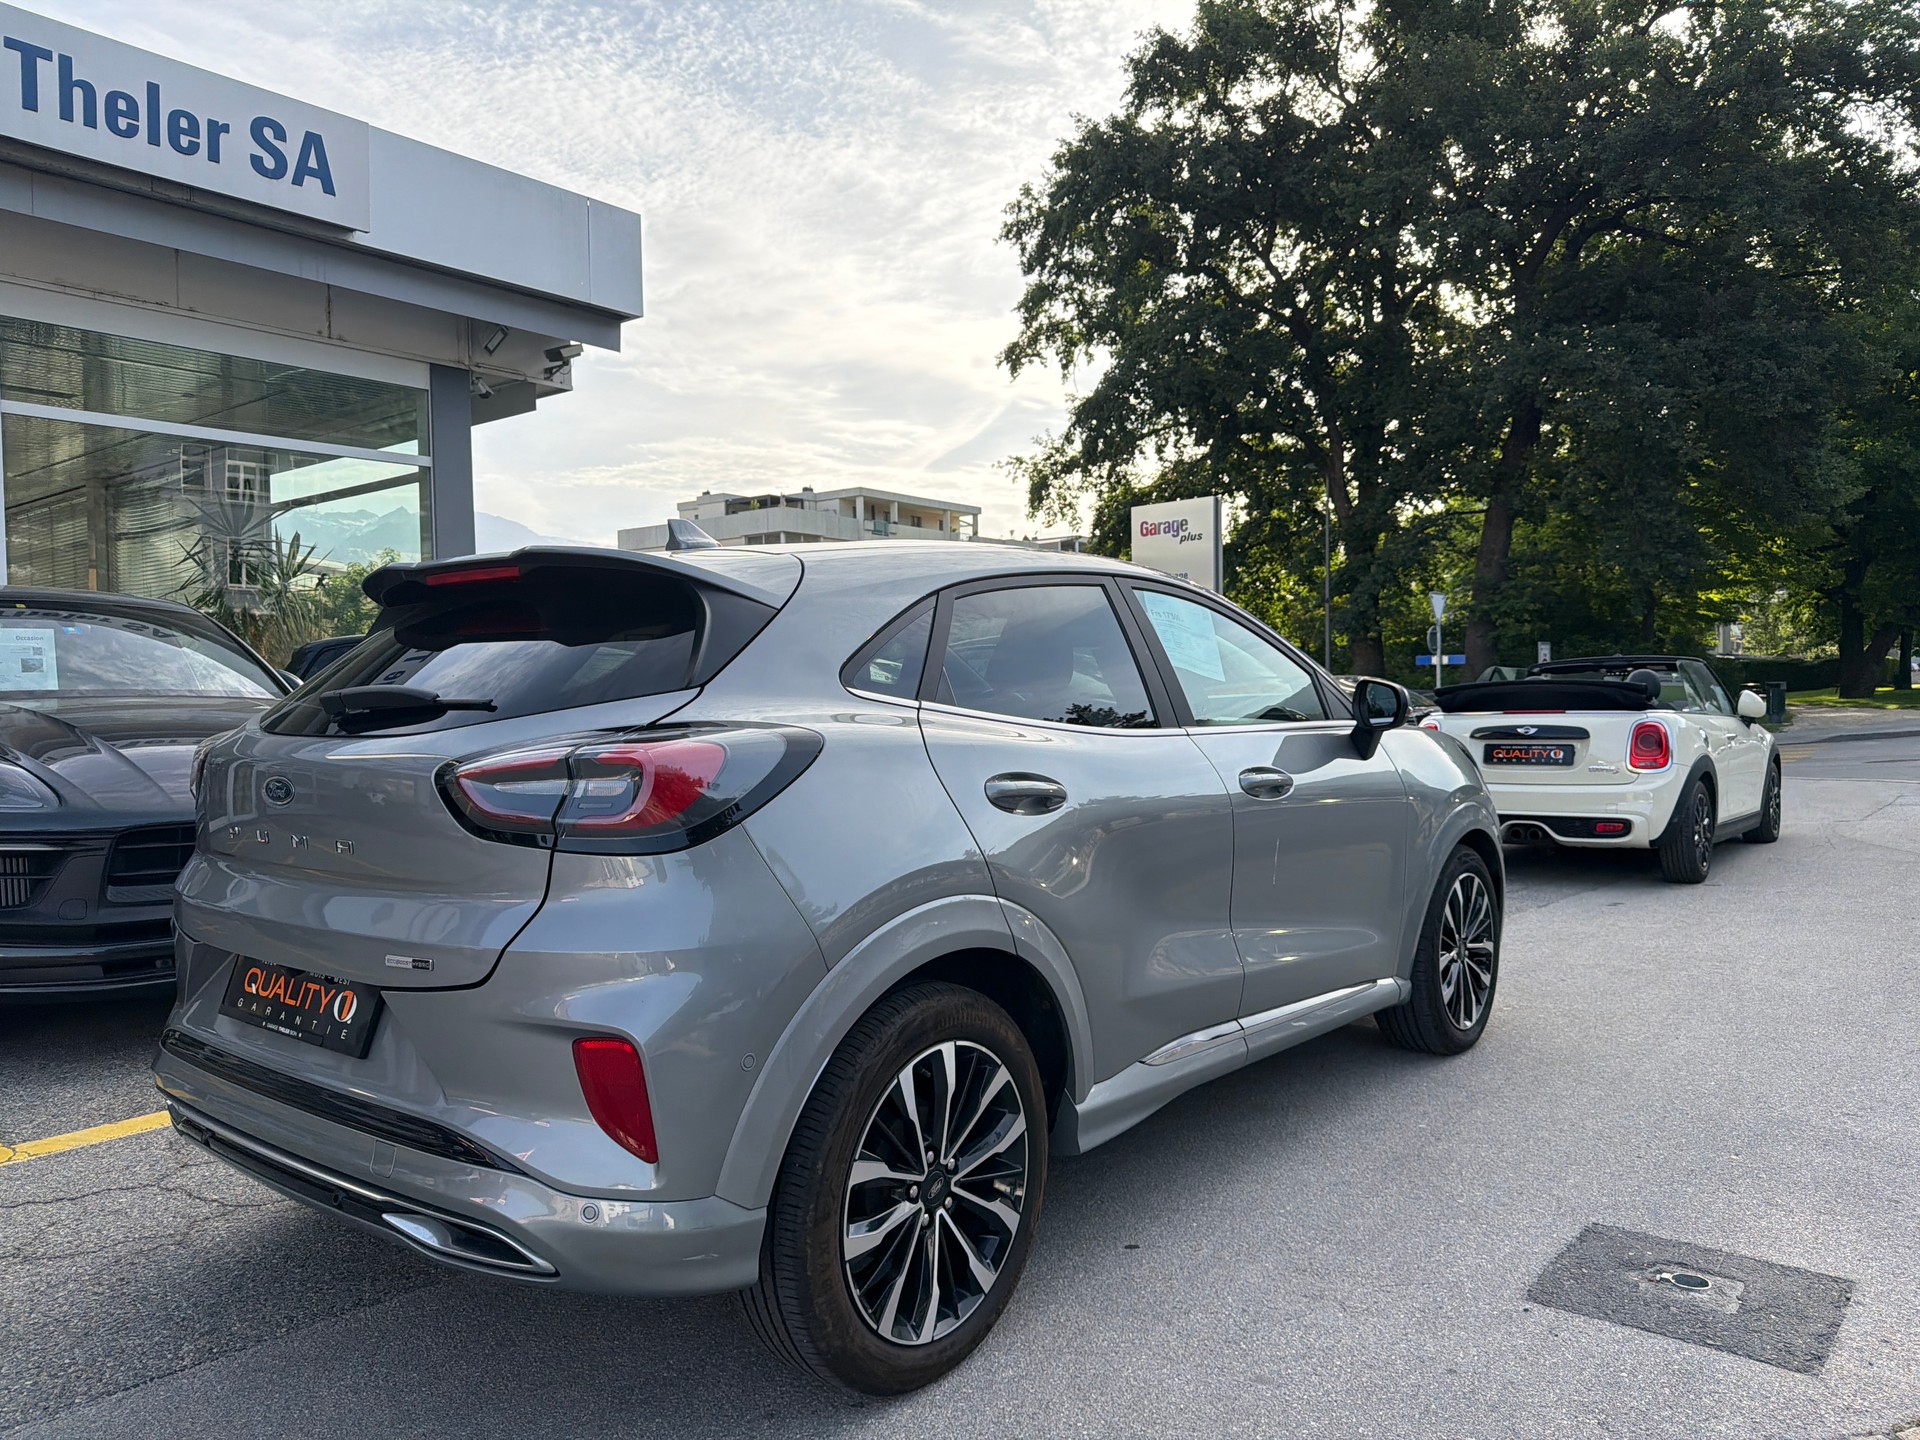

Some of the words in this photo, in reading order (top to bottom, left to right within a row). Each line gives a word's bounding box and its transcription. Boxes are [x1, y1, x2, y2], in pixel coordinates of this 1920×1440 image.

[3, 35, 230, 164] Theler
[249, 115, 336, 197] SA
[1140, 518, 1188, 538] Garage
[1179, 531, 1203, 545] plus
[1493, 749, 1550, 758] QUALITY
[267, 781, 287, 798] Ford
[229, 826, 355, 855] PUMA
[244, 967, 336, 1014] QUALITY
[237, 998, 348, 1040] GARANTIE
